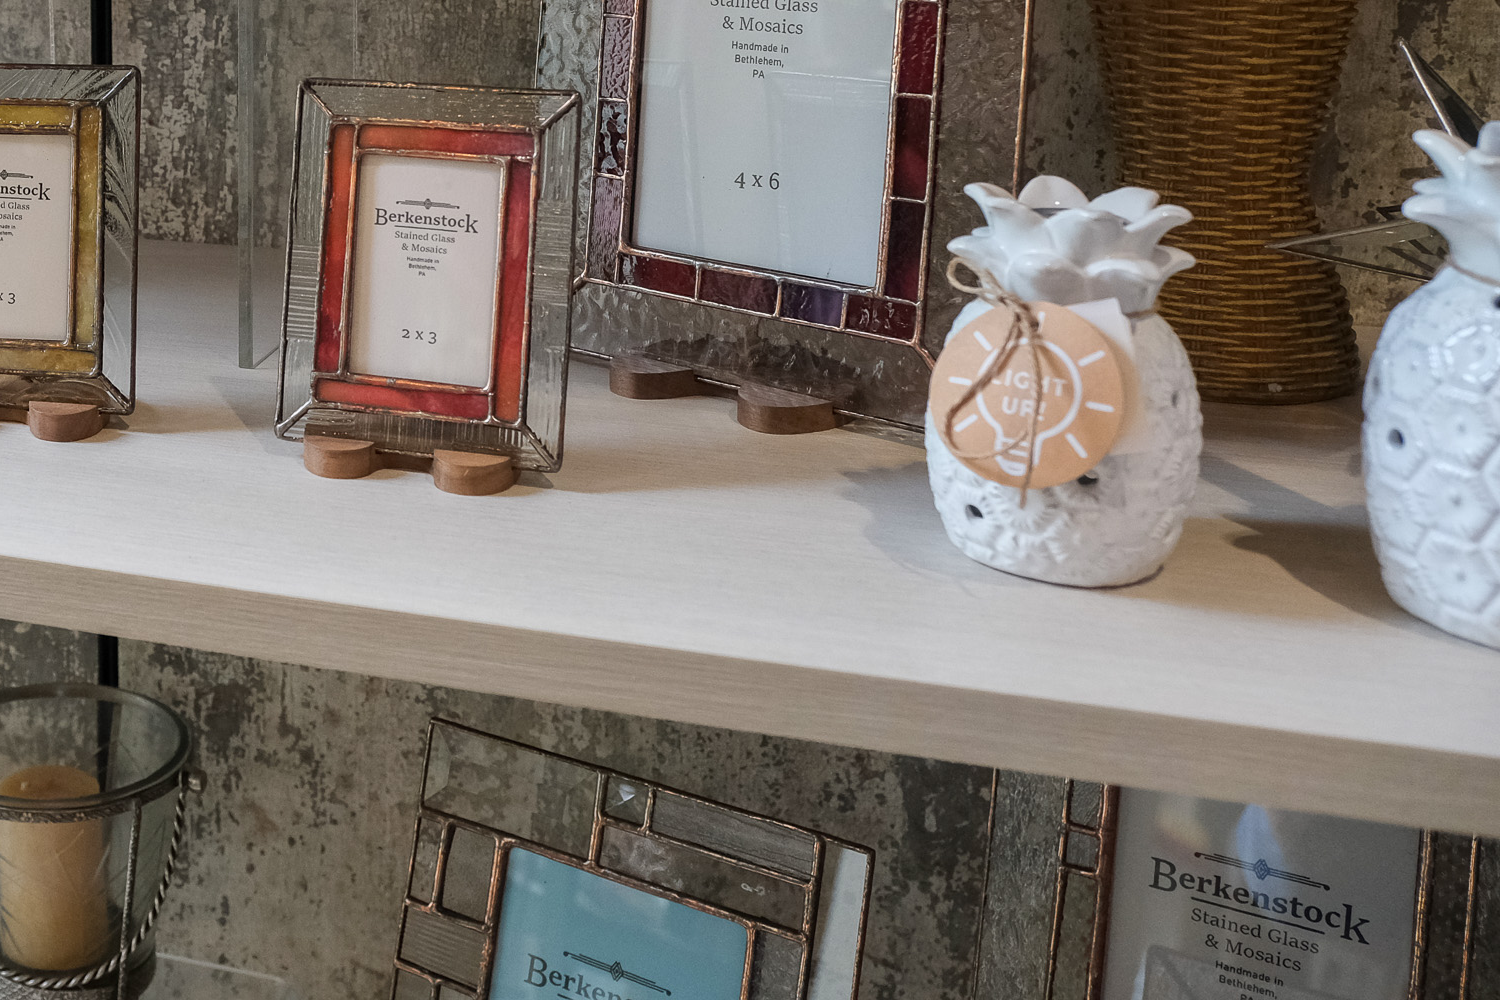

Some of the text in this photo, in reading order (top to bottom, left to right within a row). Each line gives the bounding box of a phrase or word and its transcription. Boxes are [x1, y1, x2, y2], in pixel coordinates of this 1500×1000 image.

[722, 15, 804, 35] & Mosaics
[731, 41, 778, 53] Handmade
[734, 54, 784, 68] Bethlehem,
[752, 69, 765, 79] PA
[734, 172, 780, 190] 4 x 6
[8, 201, 30, 210] Glass
[374, 207, 479, 234] Berkenstock
[394, 231, 456, 243] Stained Glass
[401, 243, 448, 254] & Mosaics
[7, 293, 16, 304] 3
[402, 328, 437, 344] 2 x 3
[1001, 396, 1047, 421] UP!
[1148, 856, 1370, 945] Berkenstock
[1191, 908, 1320, 954] Stained Glass
[1204, 934, 1301, 972] & Mosaics
[523, 953, 631, 1000] Berken
[1215, 960, 1271, 982] Handmade
[1219, 974, 1278, 1000] Bethlehem,
